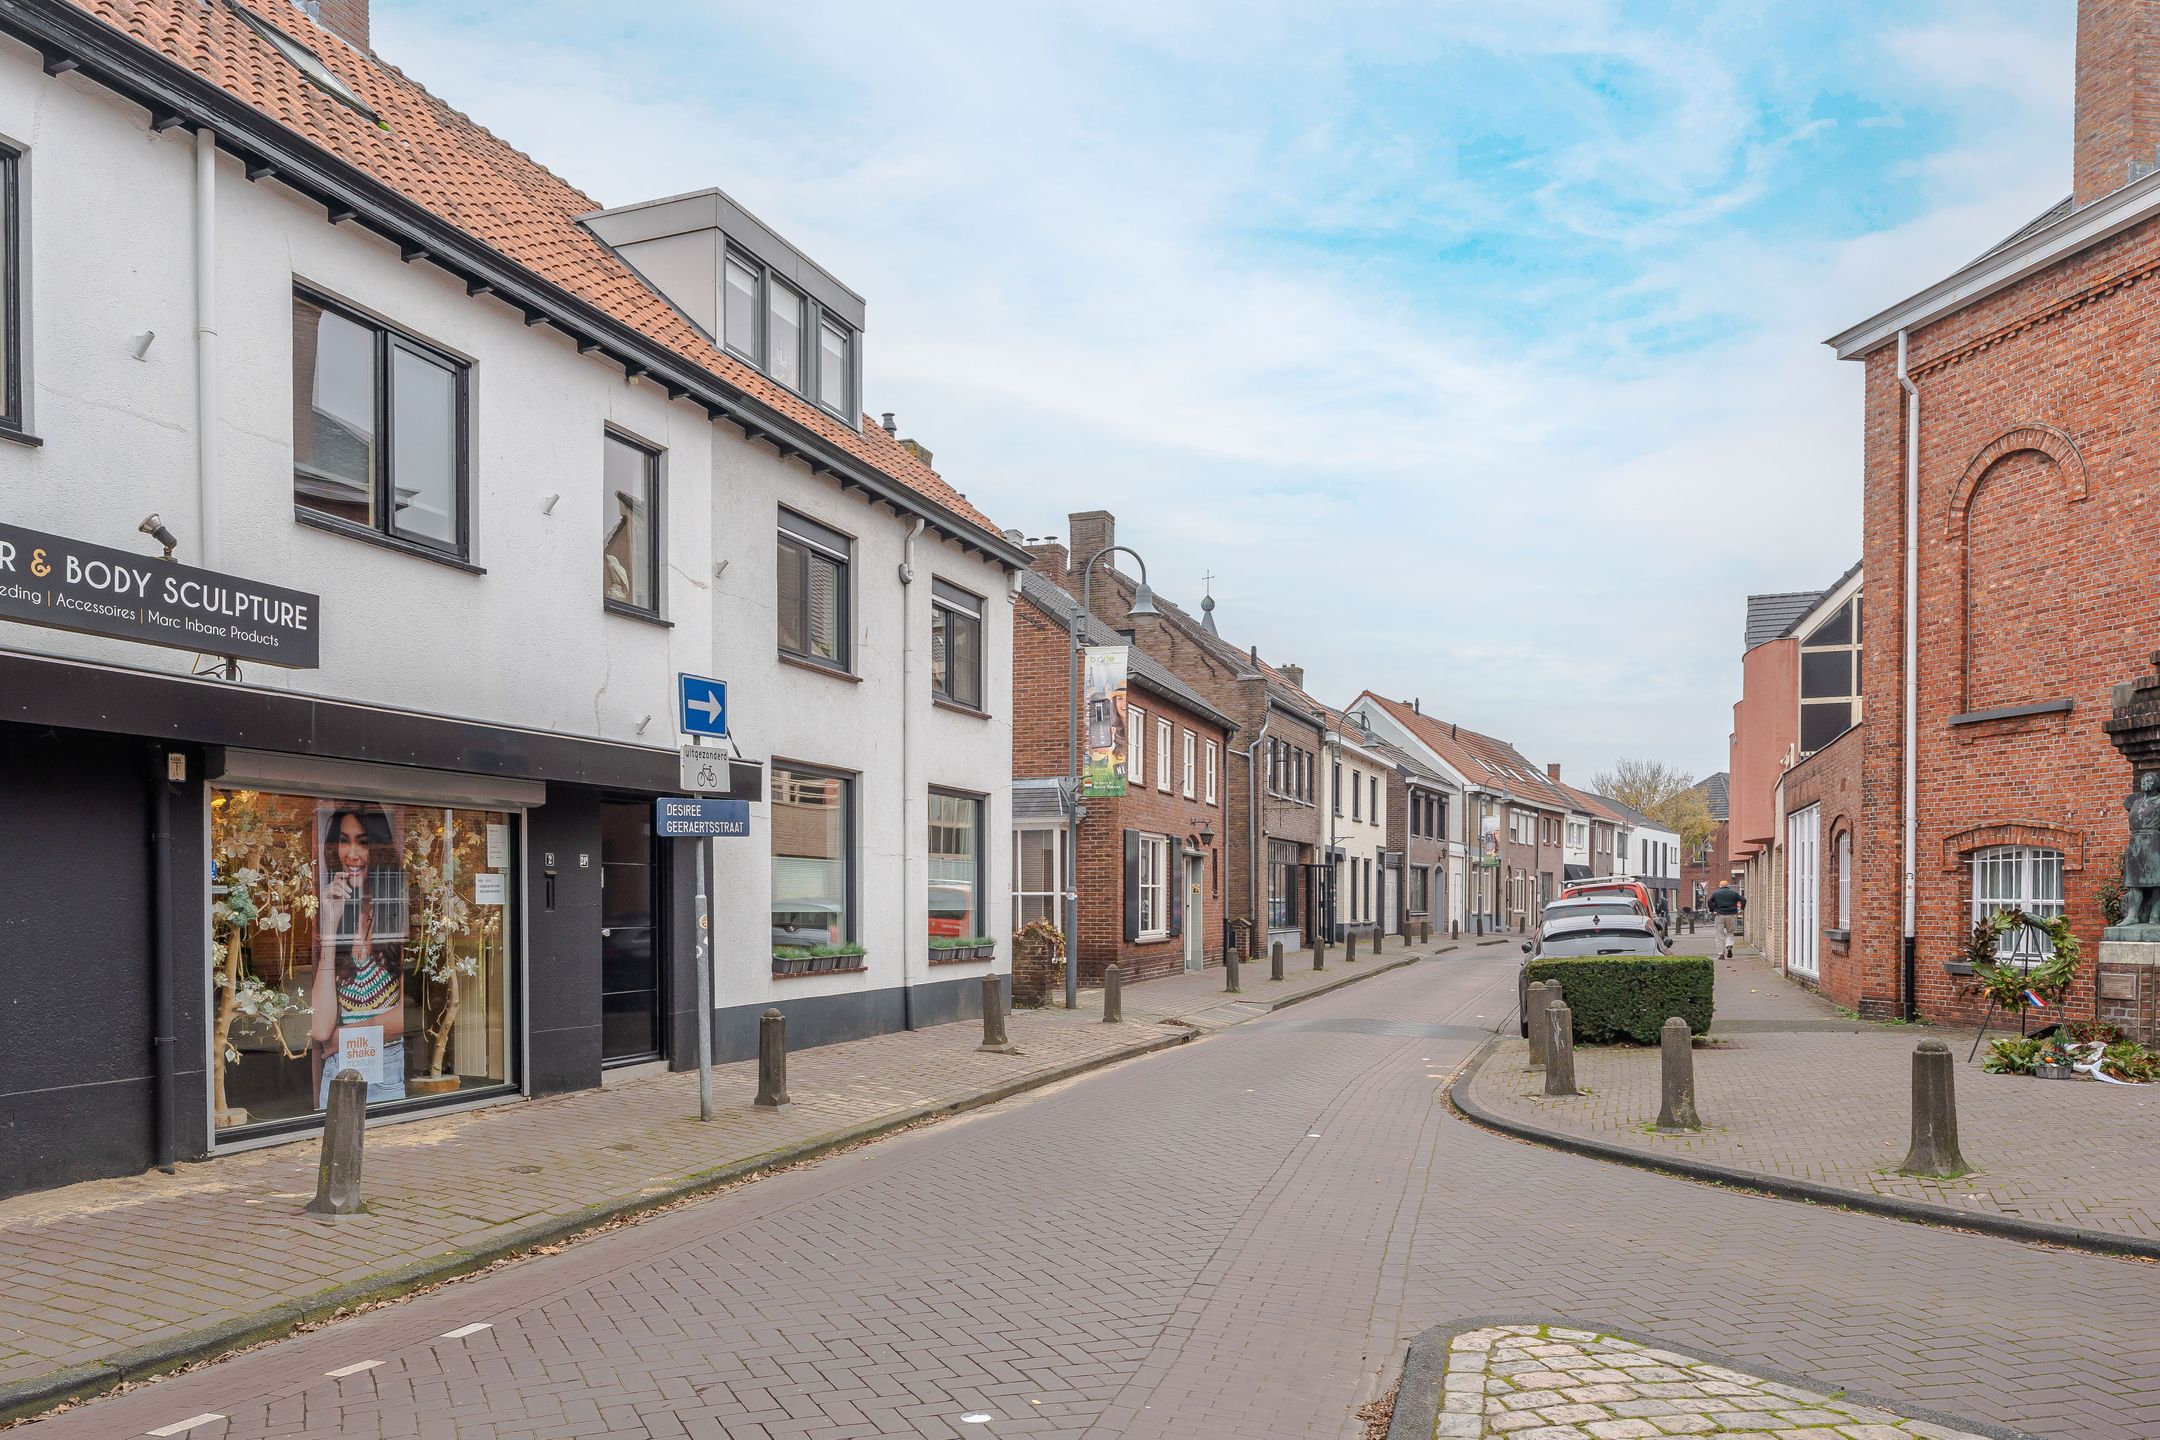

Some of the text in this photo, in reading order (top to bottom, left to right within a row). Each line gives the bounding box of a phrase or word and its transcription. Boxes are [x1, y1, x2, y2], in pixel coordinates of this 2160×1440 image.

[30, 548, 52, 577] &
[66, 555, 152, 598] BODY
[163, 577, 308, 631] SCULPTURE
[56, 593, 136, 620] Accessoires
[148, 609, 181, 628] Marc
[185, 617, 227, 637] Inbane
[230, 625, 279, 647] Products
[685, 748, 727, 761] uitgezonderd
[1116, 765, 1126, 776] NL
[666, 803, 702, 817] DESIREE
[666, 820, 744, 833] GEERAERTSSTRAAT
